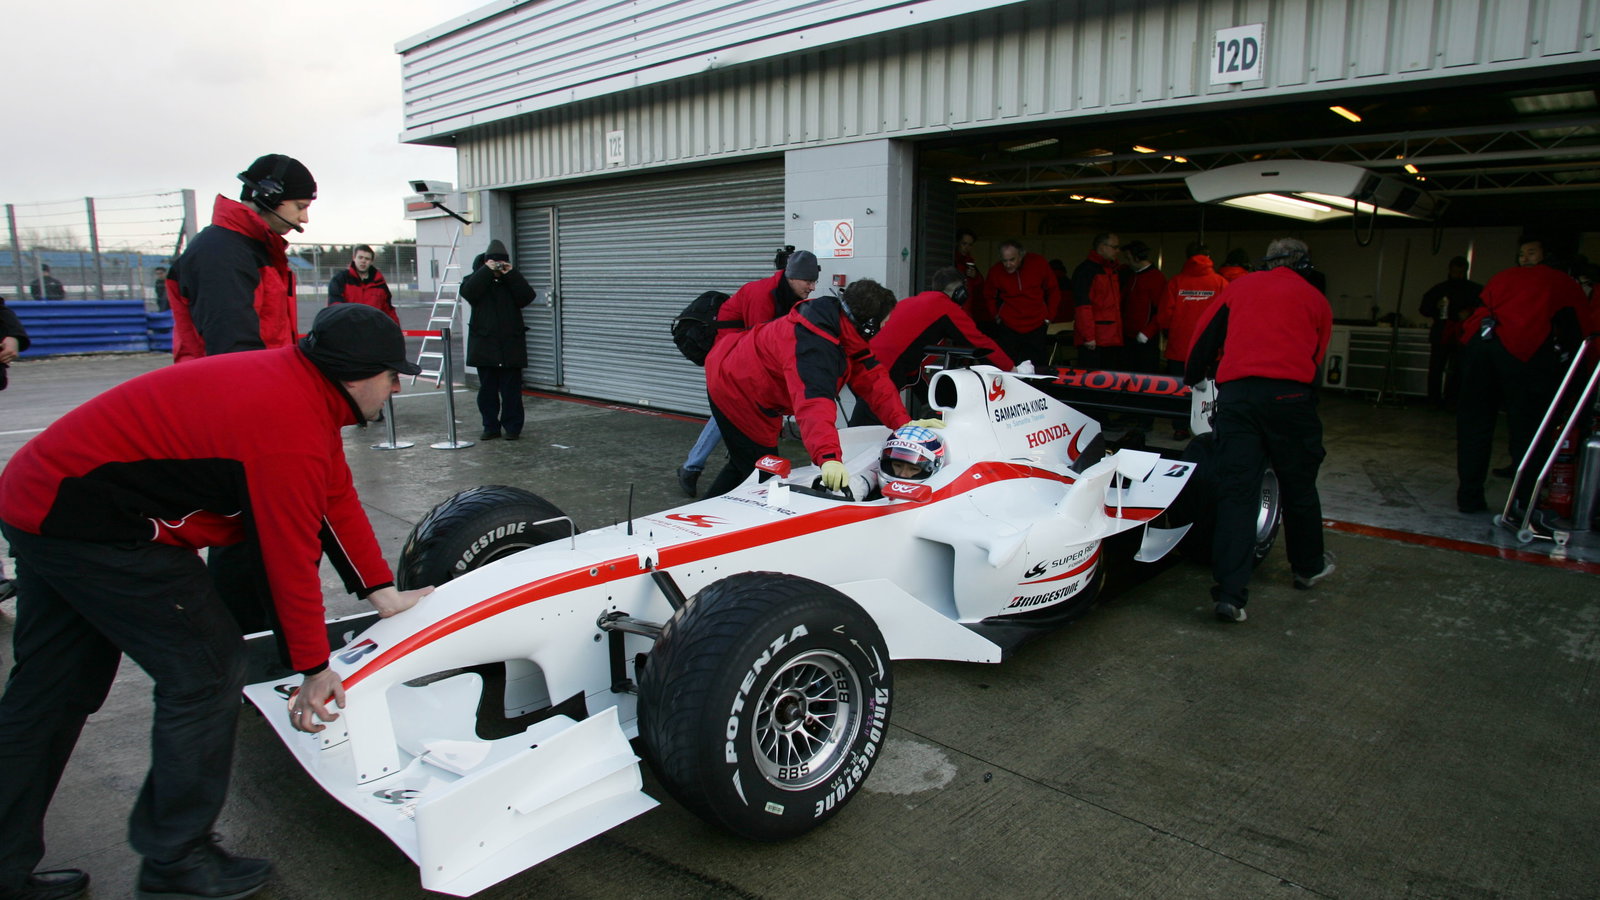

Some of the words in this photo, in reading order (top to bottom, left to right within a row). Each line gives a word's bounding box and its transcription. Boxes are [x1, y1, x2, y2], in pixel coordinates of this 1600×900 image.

[1217, 37, 1258, 73] 12D
[609, 137, 622, 157] 12E
[994, 402, 1031, 423] SAMANTHA
[1030, 398, 1048, 413] KINGZ
[886, 440, 925, 454] HONDA
[1026, 423, 1071, 448] HONDA
[455, 521, 527, 572] DGESTONE
[1051, 549, 1084, 568] SUPER
[1007, 580, 1080, 609] BRIDGESTONE
[725, 624, 809, 763] POTENZA
[832, 669, 850, 704] BBS
[814, 688, 889, 818] BRIDGESTONE
[778, 763, 810, 780] BBS
